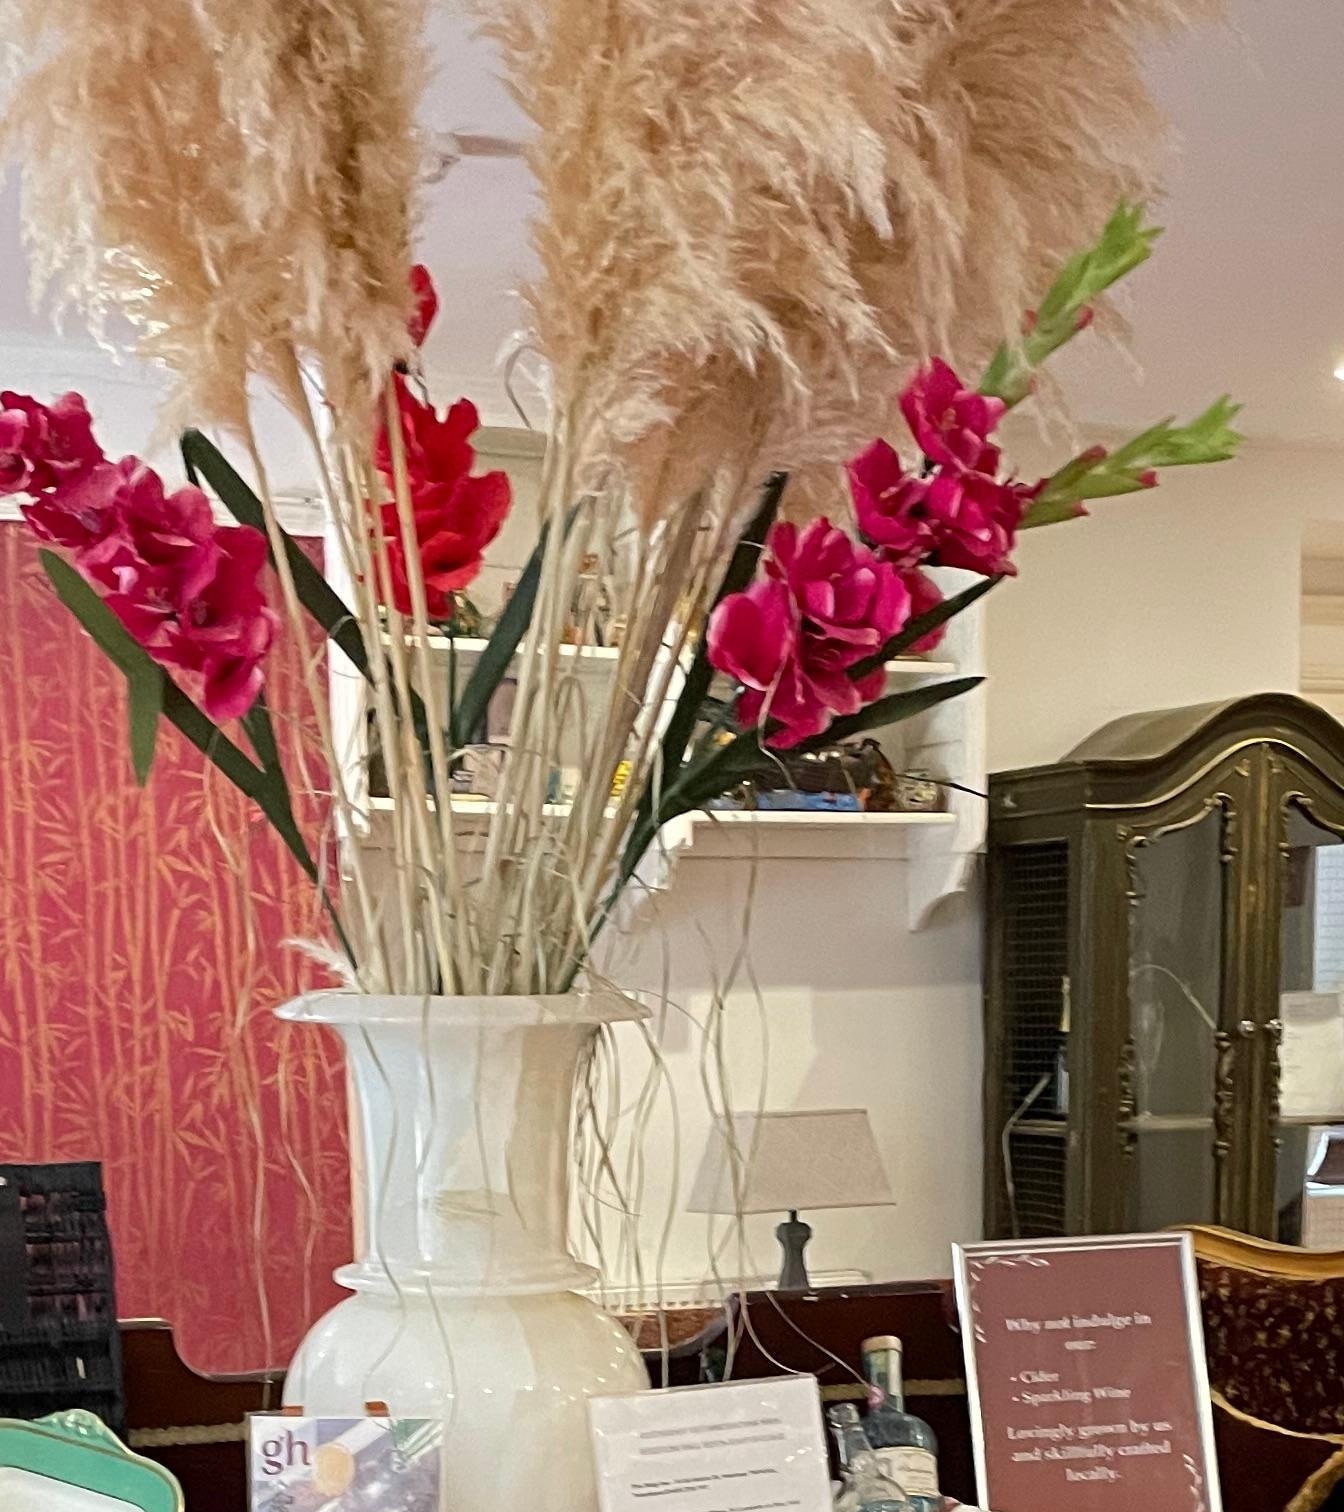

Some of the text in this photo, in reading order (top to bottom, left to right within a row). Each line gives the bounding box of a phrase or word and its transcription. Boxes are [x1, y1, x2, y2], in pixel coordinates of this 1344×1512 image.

[1006, 1318, 1041, 1334] Why
[1072, 1313, 1132, 1330] indulge
[1134, 1311, 1152, 1325] in
[1021, 1387, 1131, 1407] Sparkling Wine
[1129, 1419, 1149, 1436] by
[261, 1429, 311, 1475] gh
